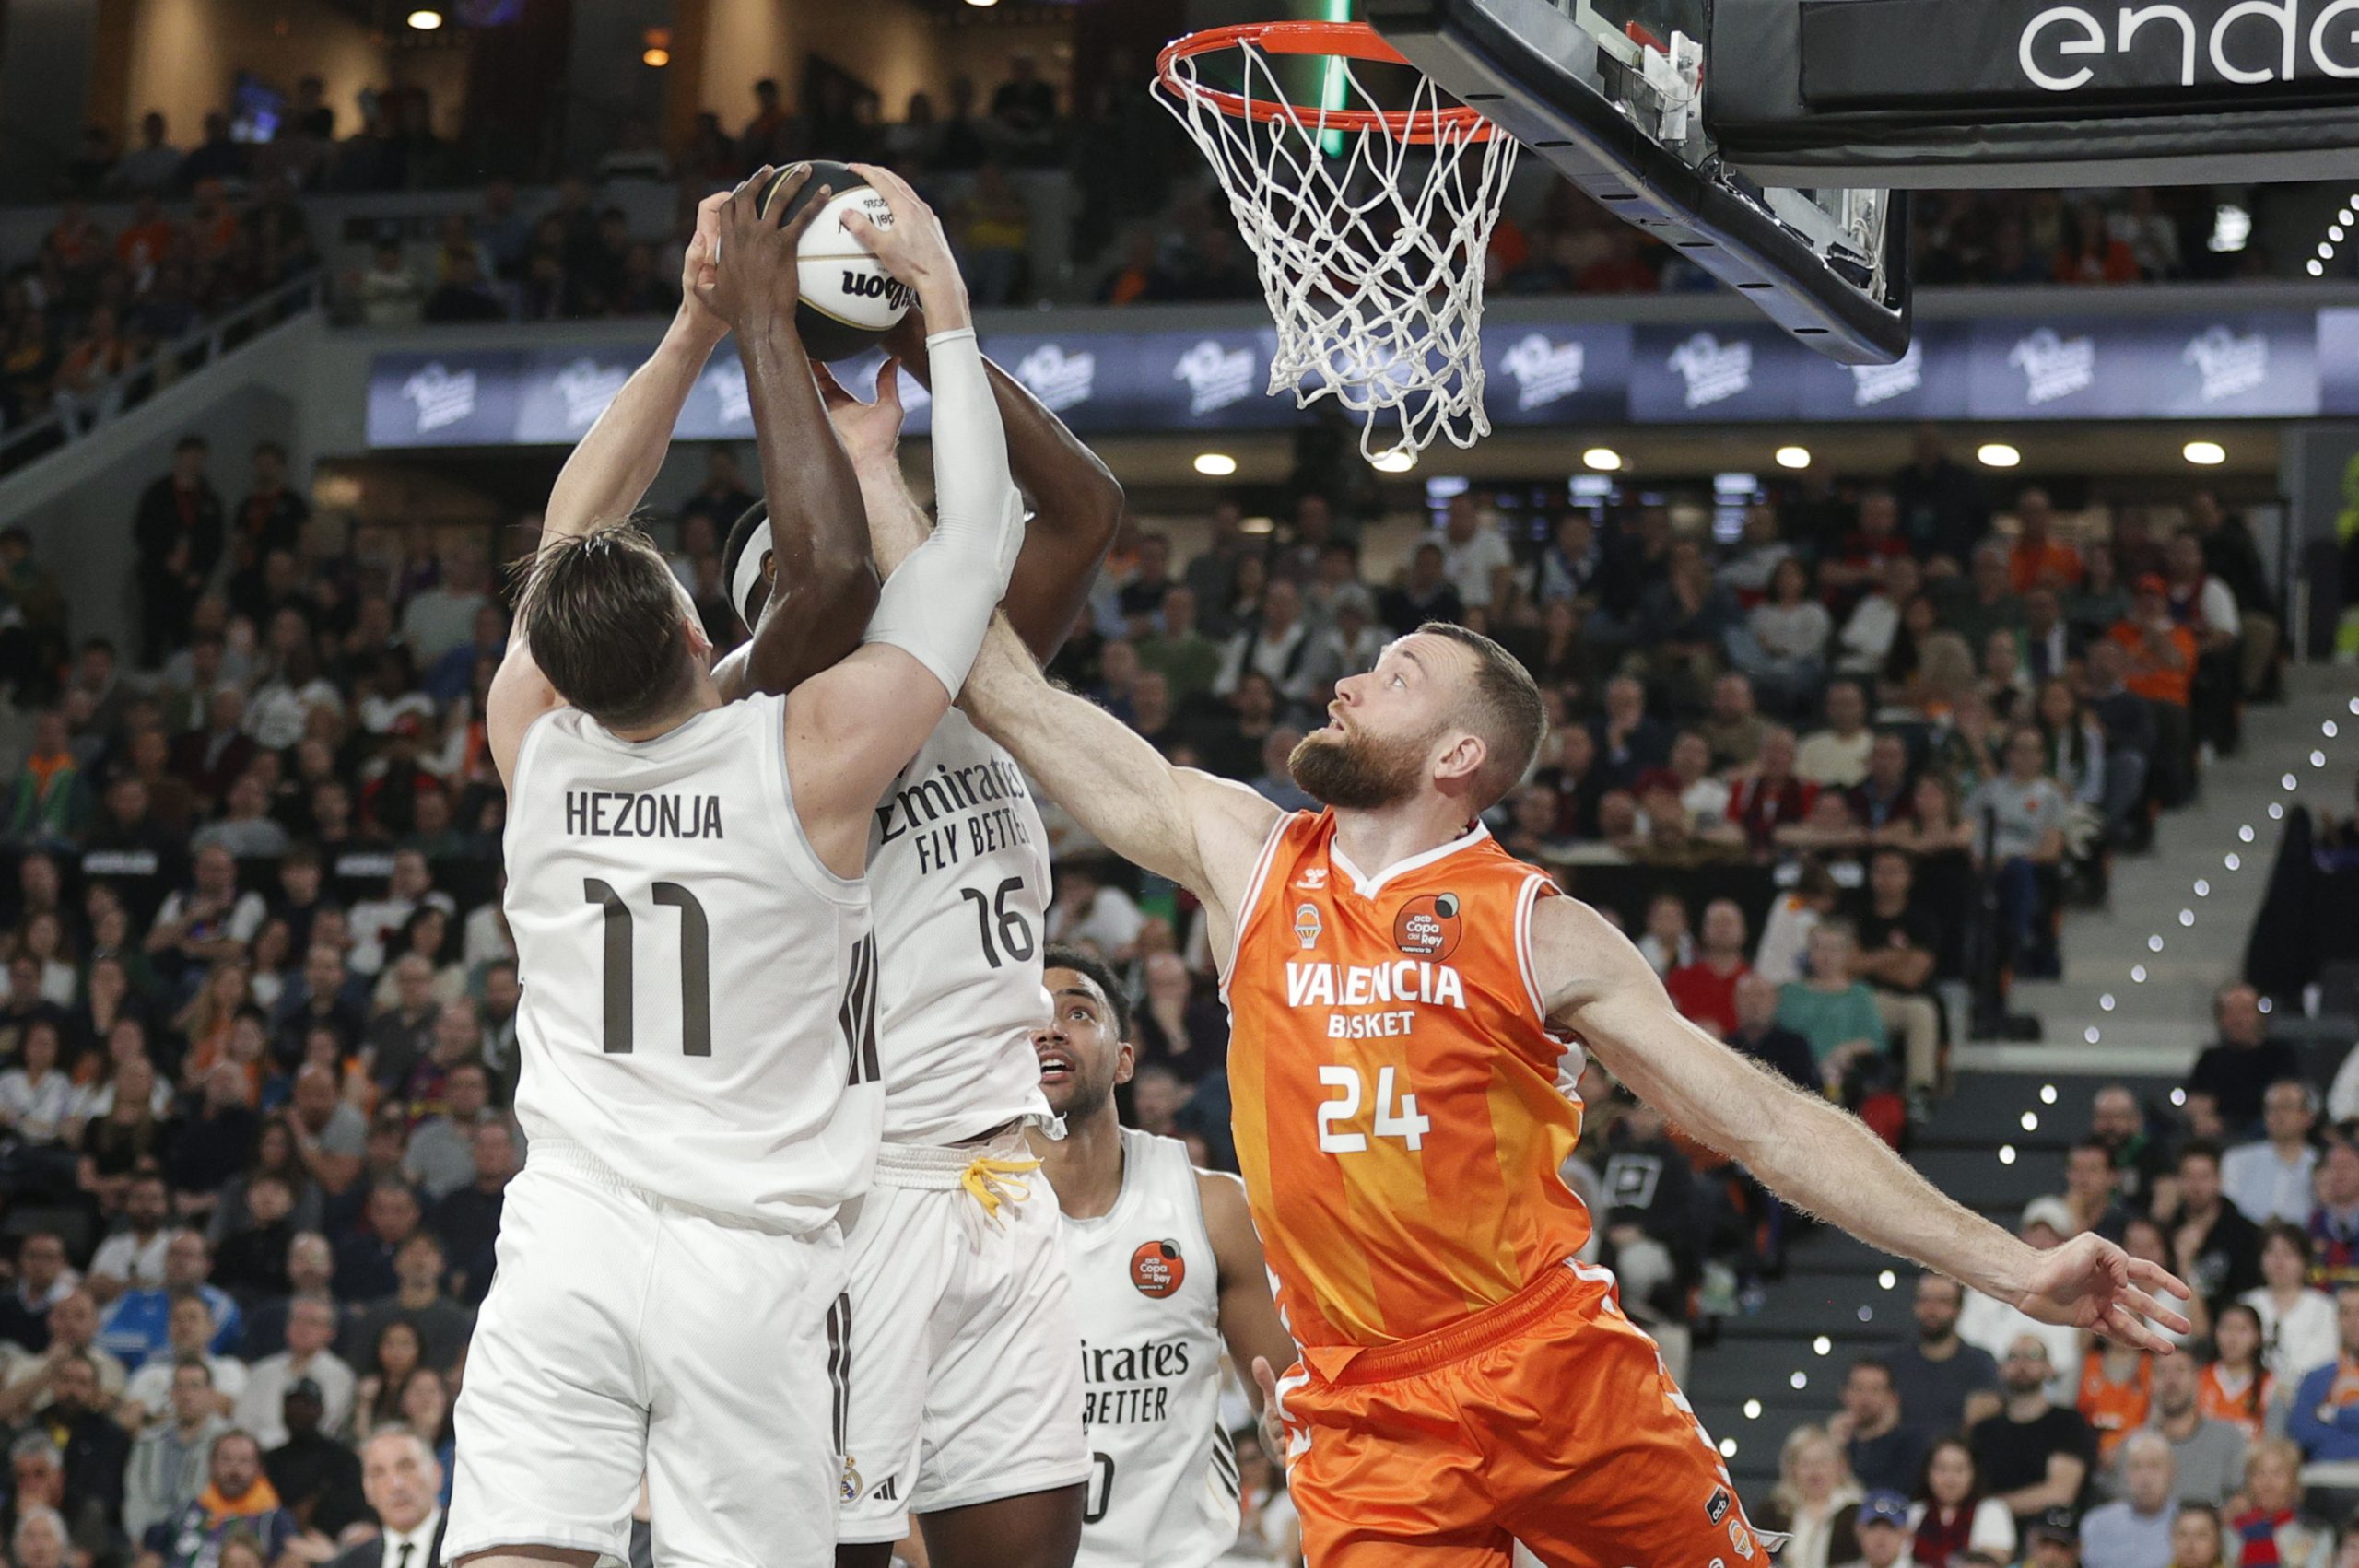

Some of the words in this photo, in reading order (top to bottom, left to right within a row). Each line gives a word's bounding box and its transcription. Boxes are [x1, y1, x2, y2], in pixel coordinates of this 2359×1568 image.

[2019, 0, 2359, 91] ende
[841, 270, 922, 311] ilson
[566, 791, 723, 839] HEZONJA
[875, 754, 1026, 845] Emirates
[915, 824, 958, 875] FLY
[960, 876, 1035, 969] 16
[1406, 921, 1439, 935] Copa
[1414, 915, 1432, 923] acb
[1421, 934, 1443, 947] Rey
[583, 877, 712, 1057] 11
[1317, 1065, 1431, 1153] 24
[1139, 1263, 1168, 1274] Copa
[1153, 1273, 1172, 1284] Rey
[1081, 1339, 1189, 1384] irates
